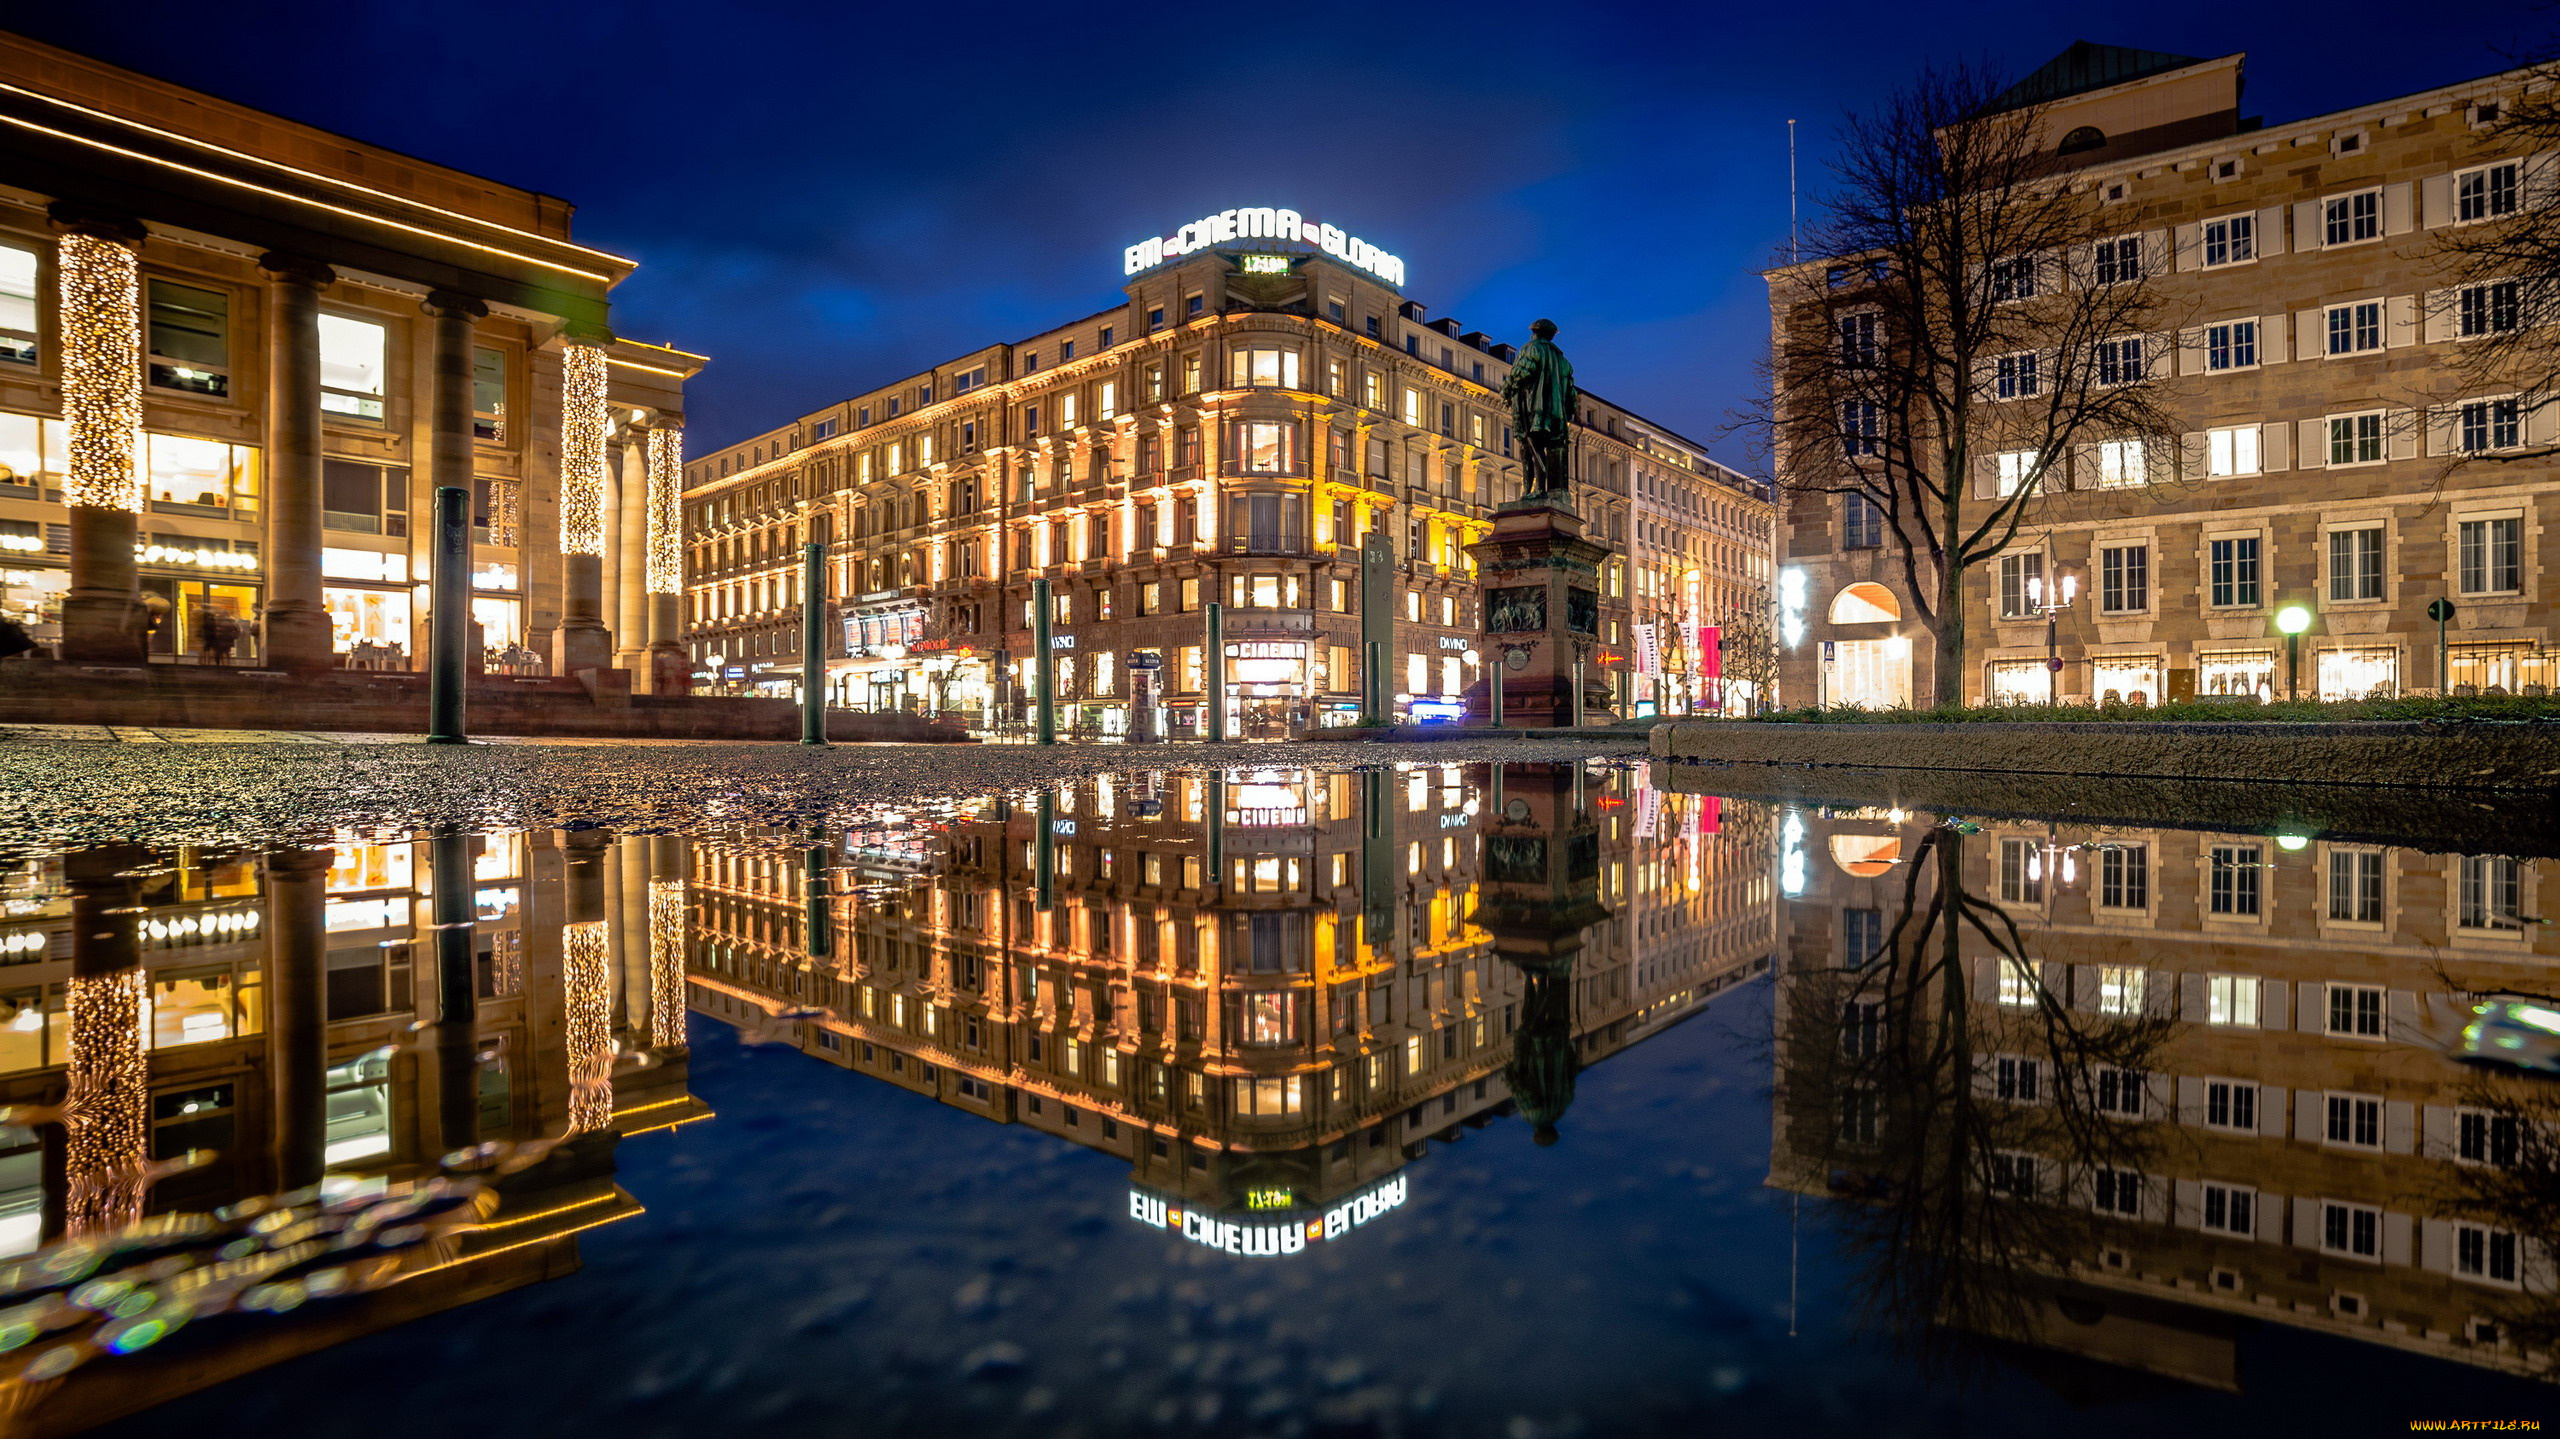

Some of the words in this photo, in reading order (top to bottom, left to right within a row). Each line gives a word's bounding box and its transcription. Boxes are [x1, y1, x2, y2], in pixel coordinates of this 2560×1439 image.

[1124, 236, 1163, 276] EM
[1177, 207, 1302, 255] CINEMA
[1320, 223, 1405, 287] GLORIA
[1240, 643, 1306, 659] CINEMA
